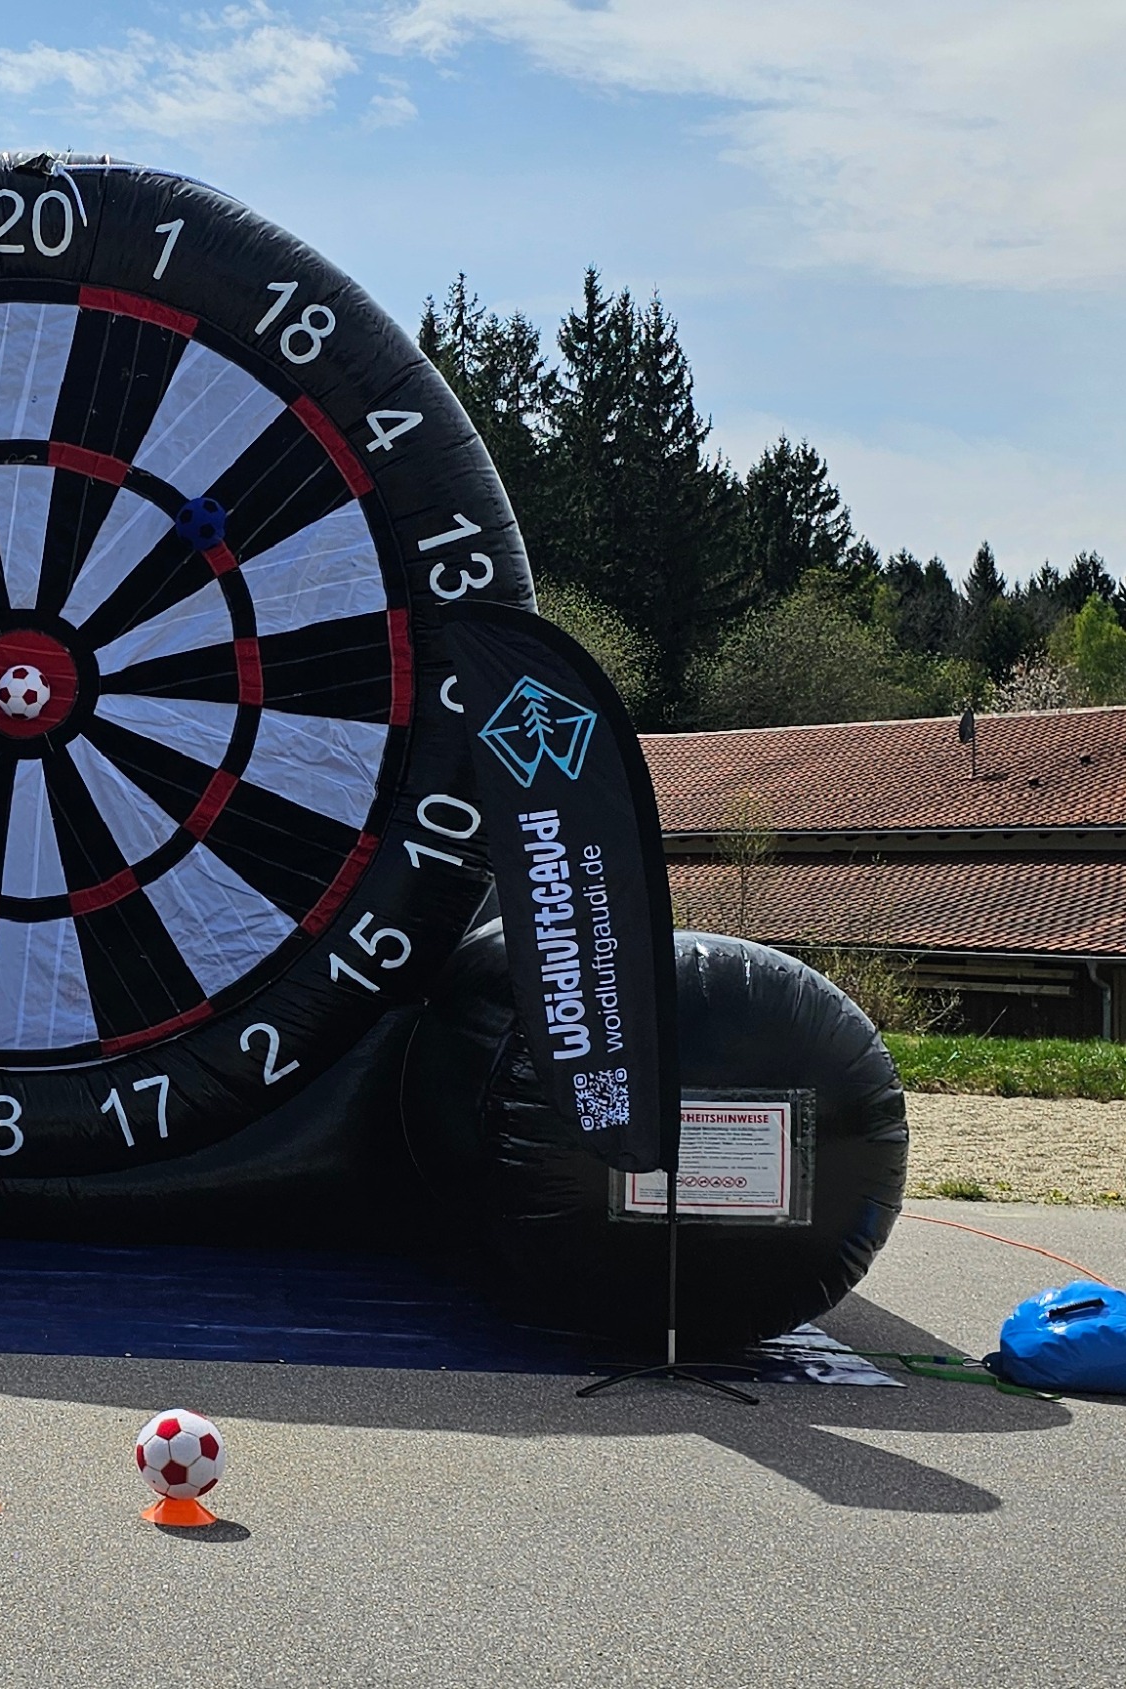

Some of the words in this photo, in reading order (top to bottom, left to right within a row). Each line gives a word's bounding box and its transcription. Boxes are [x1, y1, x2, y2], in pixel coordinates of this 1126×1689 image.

[153, 219, 185, 280] 1
[255, 281, 336, 364] 18
[366, 410, 424, 453] 4
[418, 513, 494, 600] 13
[404, 794, 481, 869] 10
[329, 911, 412, 992] 15
[579, 844, 623, 1053] woidluftgaudi.de
[240, 1022, 300, 1085] 2
[101, 1074, 170, 1147] 17
